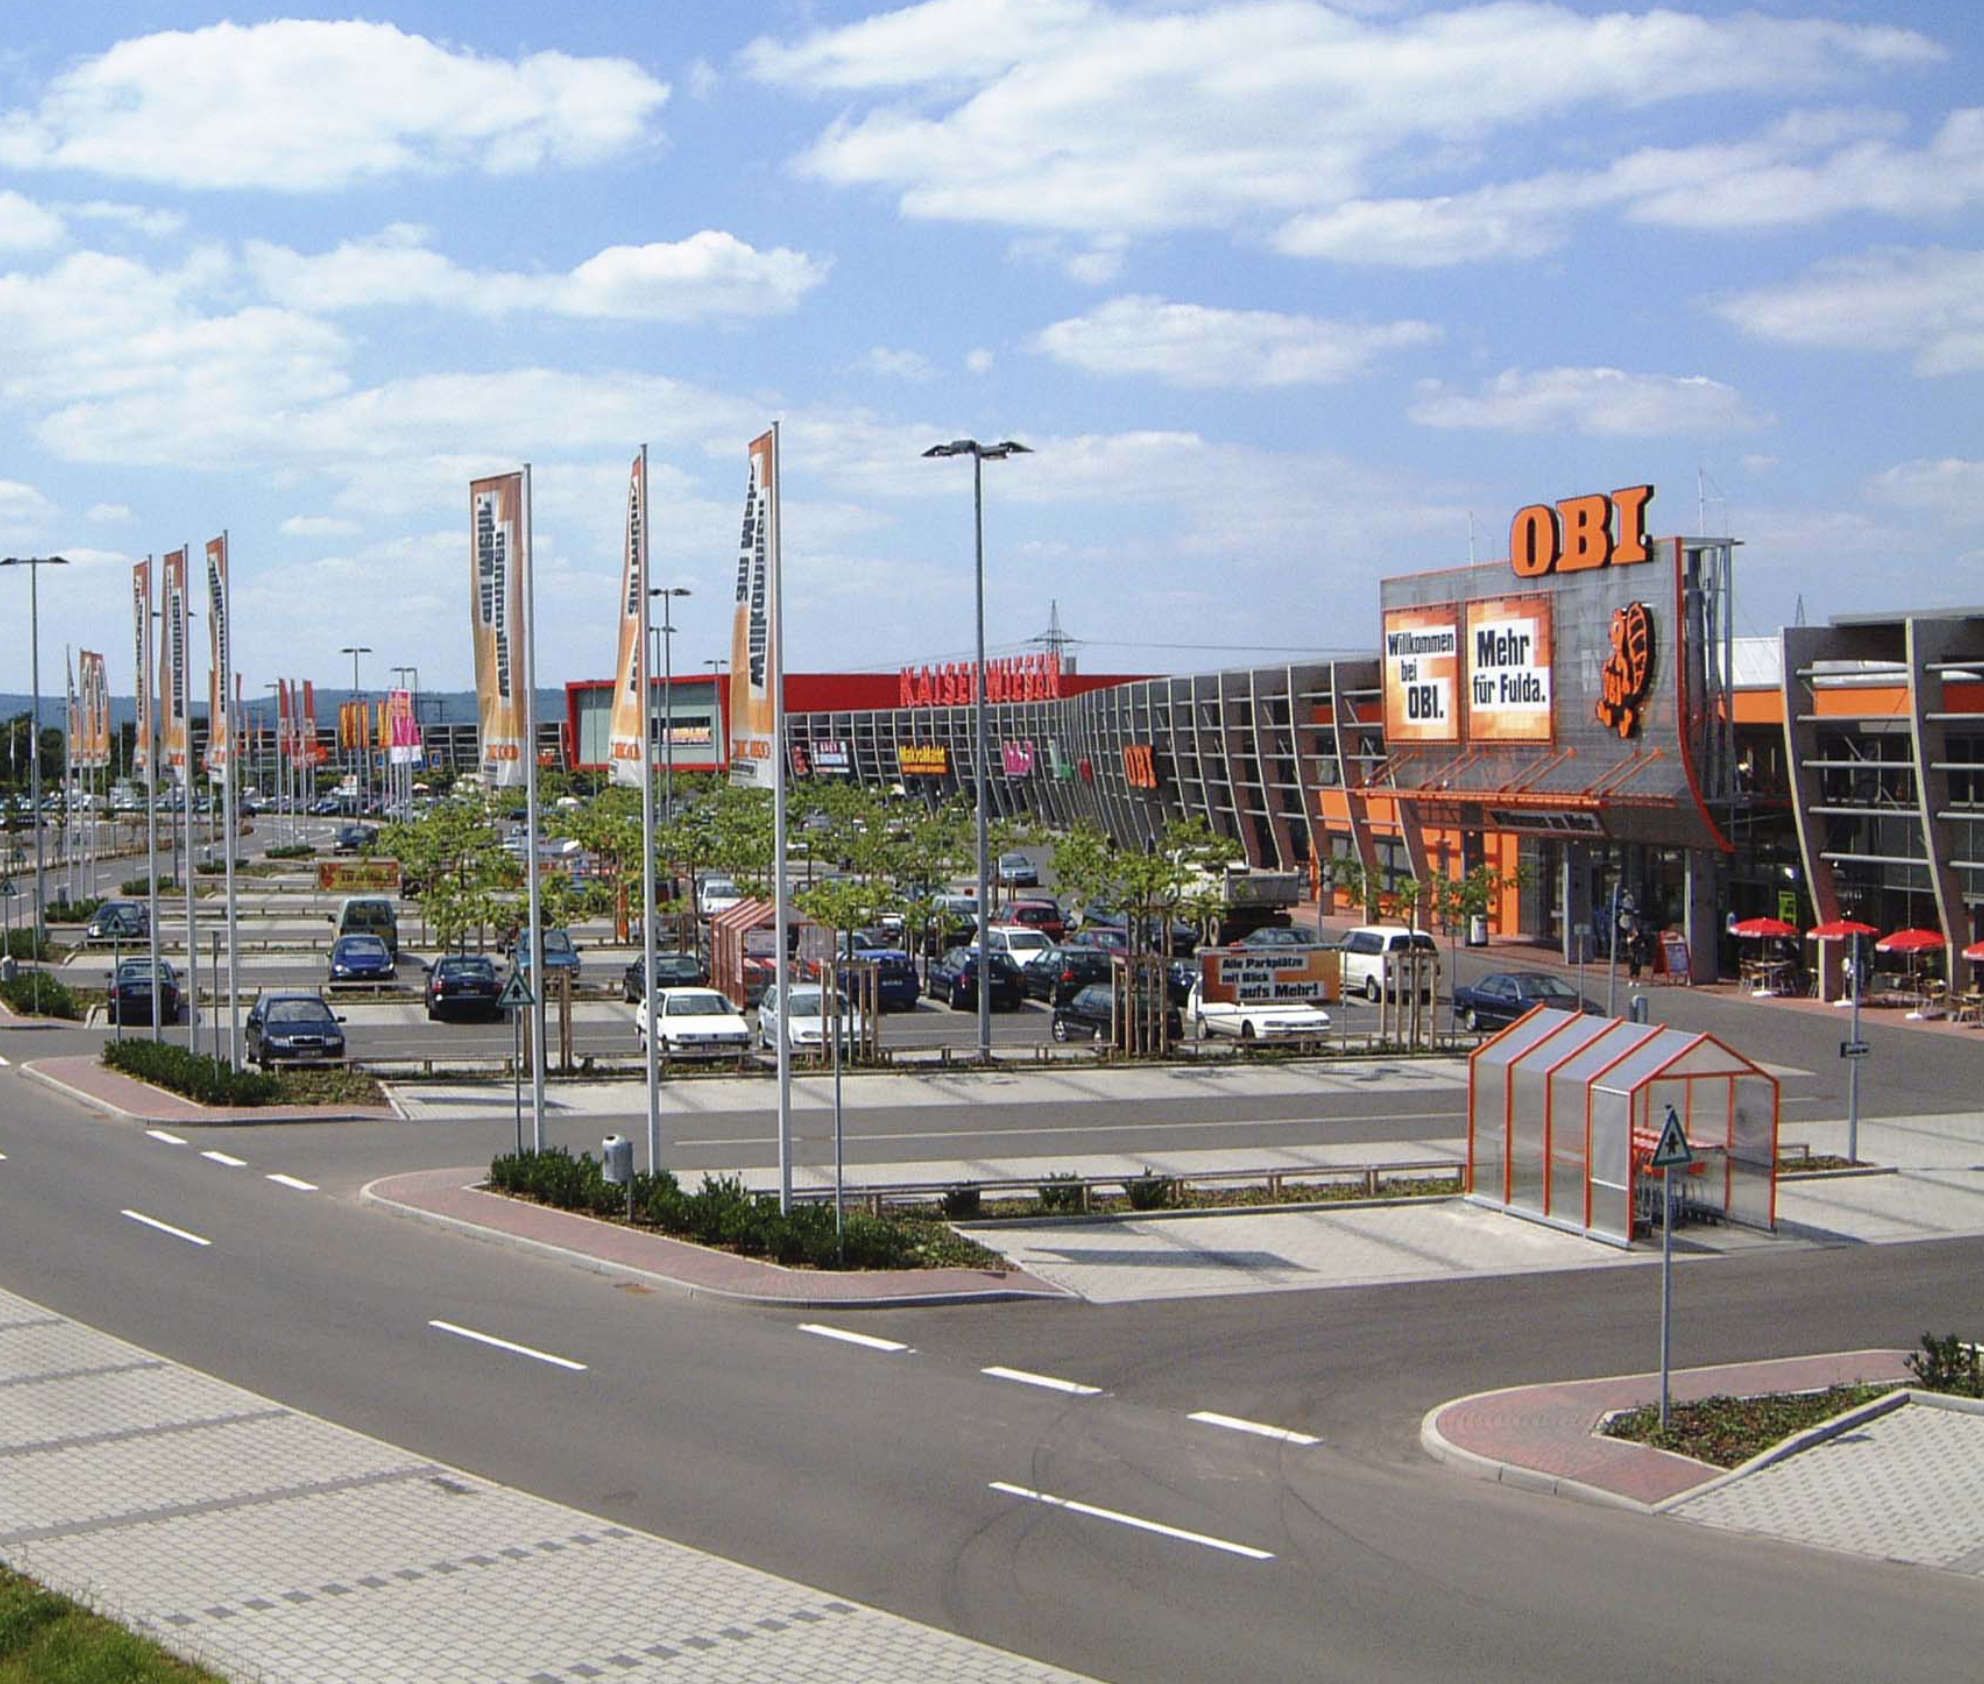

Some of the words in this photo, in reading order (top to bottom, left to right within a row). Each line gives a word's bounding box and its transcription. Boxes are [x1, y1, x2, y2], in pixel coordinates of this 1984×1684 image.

[1510, 484, 1654, 579] OBI
[1387, 631, 1454, 656] Willkommen
[1477, 628, 1530, 667] Mehr
[1401, 657, 1417, 682] bei
[1408, 684, 1444, 719] OBI.
[1473, 674, 1496, 704] für
[1500, 671, 1546, 703] Fulda.
[1124, 744, 1158, 789] OBI
[1222, 956, 1243, 969] Alle
[1245, 956, 1303, 969] Parkplätze
[1222, 971, 1239, 982] mit
[1242, 970, 1269, 982] Blick
[1239, 984, 1270, 998] aufs
